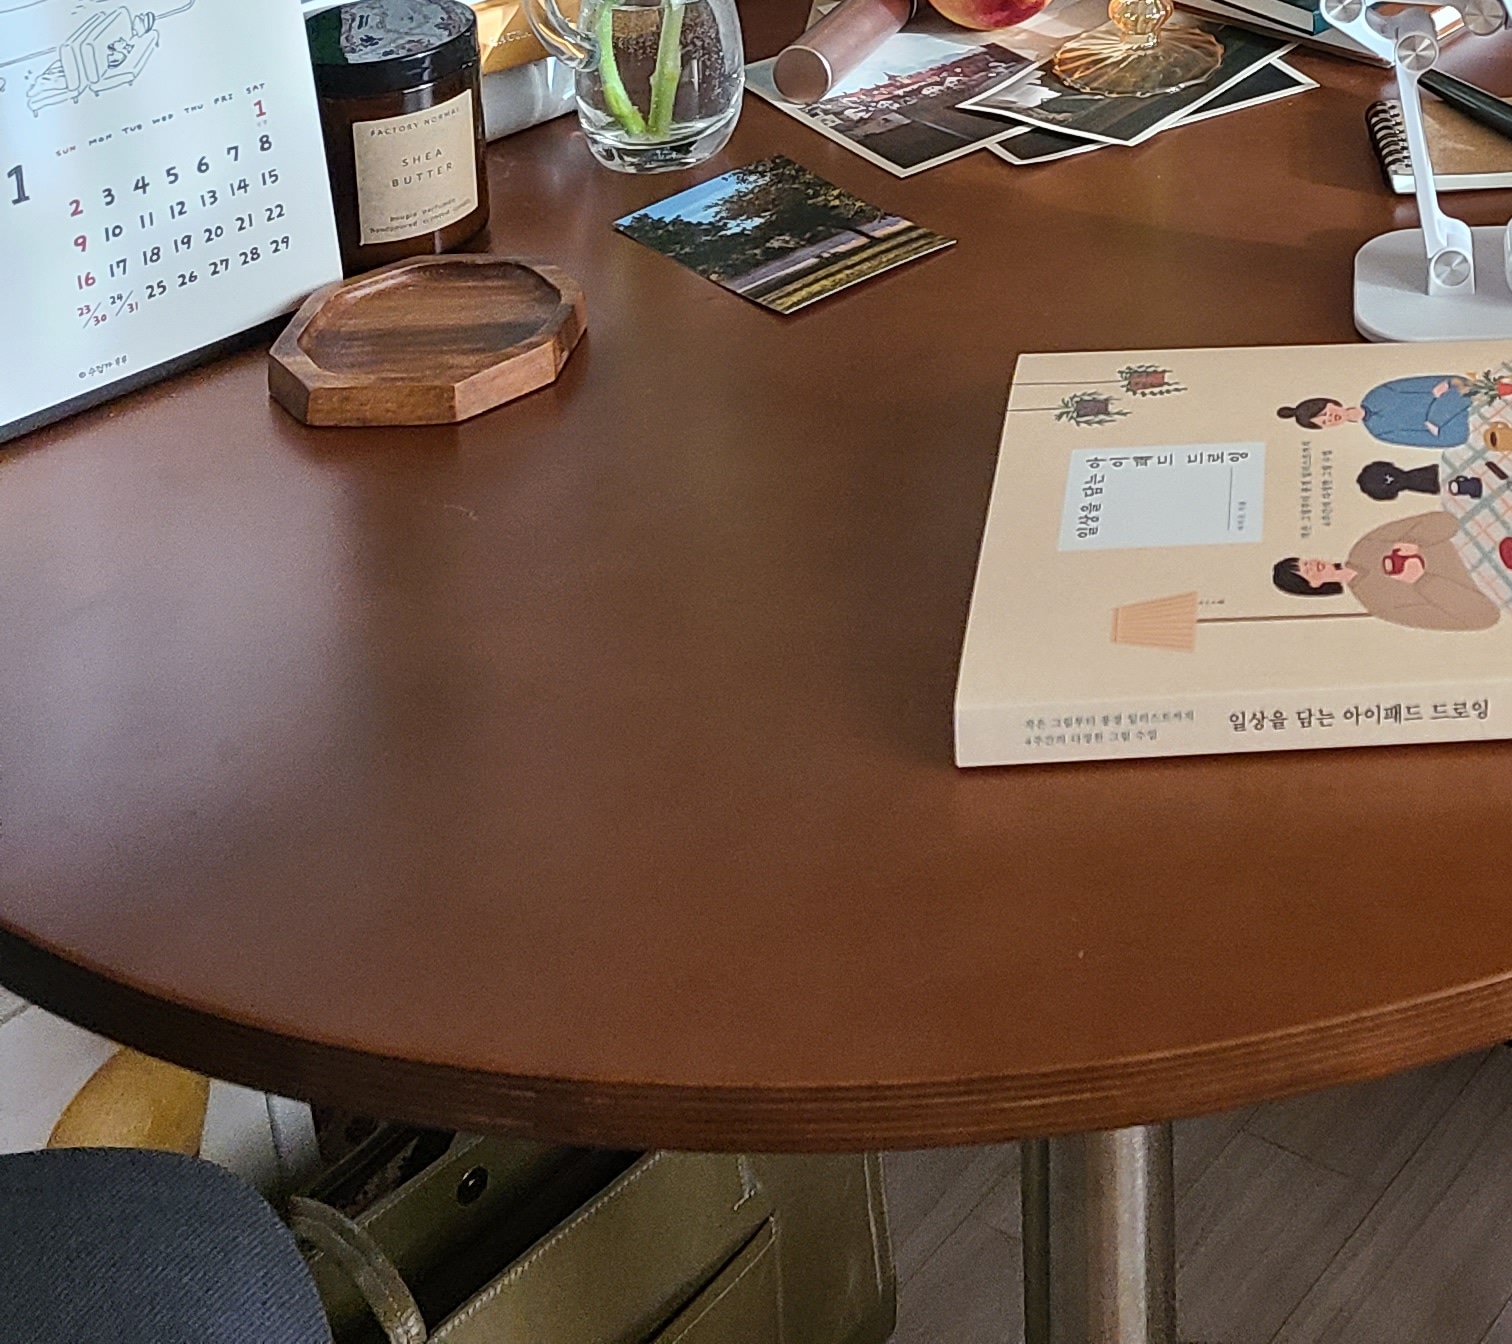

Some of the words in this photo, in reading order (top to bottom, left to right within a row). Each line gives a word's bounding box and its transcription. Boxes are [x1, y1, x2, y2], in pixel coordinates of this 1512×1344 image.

[56, 145, 77, 157] SUN
[88, 133, 112, 146] MON
[121, 123, 143, 134] TUE
[152, 113, 174, 125] WED
[183, 102, 204, 114] THU
[213, 93, 233, 105] FRI
[245, 82, 265, 95] SAT
[253, 99, 267, 118] 1
[370, 122, 420, 137] FACTORY
[69, 199, 84, 217] 2
[102, 187, 116, 207] 3
[133, 176, 150, 195] 4
[165, 166, 179, 185] 5
[196, 156, 210, 174] 6
[226, 145, 240, 162] 7
[258, 134, 273, 152] 8
[391, 162, 454, 188] BUTTER
[402, 148, 443, 168] SHEA
[6, 164, 31, 206] 1
[73, 234, 88, 253] 9
[104, 224, 123, 242] 10
[139, 211, 154, 229] 11
[168, 200, 188, 220] 12
[200, 189, 219, 208] 13
[229, 178, 250, 197] 14
[261, 168, 279, 186] 15
[77, 272, 96, 291] 16
[108, 258, 128, 278] 17
[142, 246, 161, 266] 18
[173, 234, 192, 254] 19
[203, 225, 224, 244] 20
[234, 213, 254, 232] 21
[264, 203, 286, 223] 22
[145, 279, 168, 300] 25
[176, 270, 198, 288] 26
[208, 258, 231, 276] 27
[238, 246, 261, 266] 28
[269, 235, 291, 254] 29
[1085, 452, 1174, 468] 아이패드
[1186, 451, 1249, 466] 드로잉
[1082, 473, 1105, 498] 담는
[1076, 502, 1101, 539] 일상을
[1229, 709, 1288, 732] 일상을
[1296, 707, 1336, 729] 담는
[1343, 703, 1424, 727] 아이패드
[1431, 699, 1490, 722] 드로잉
